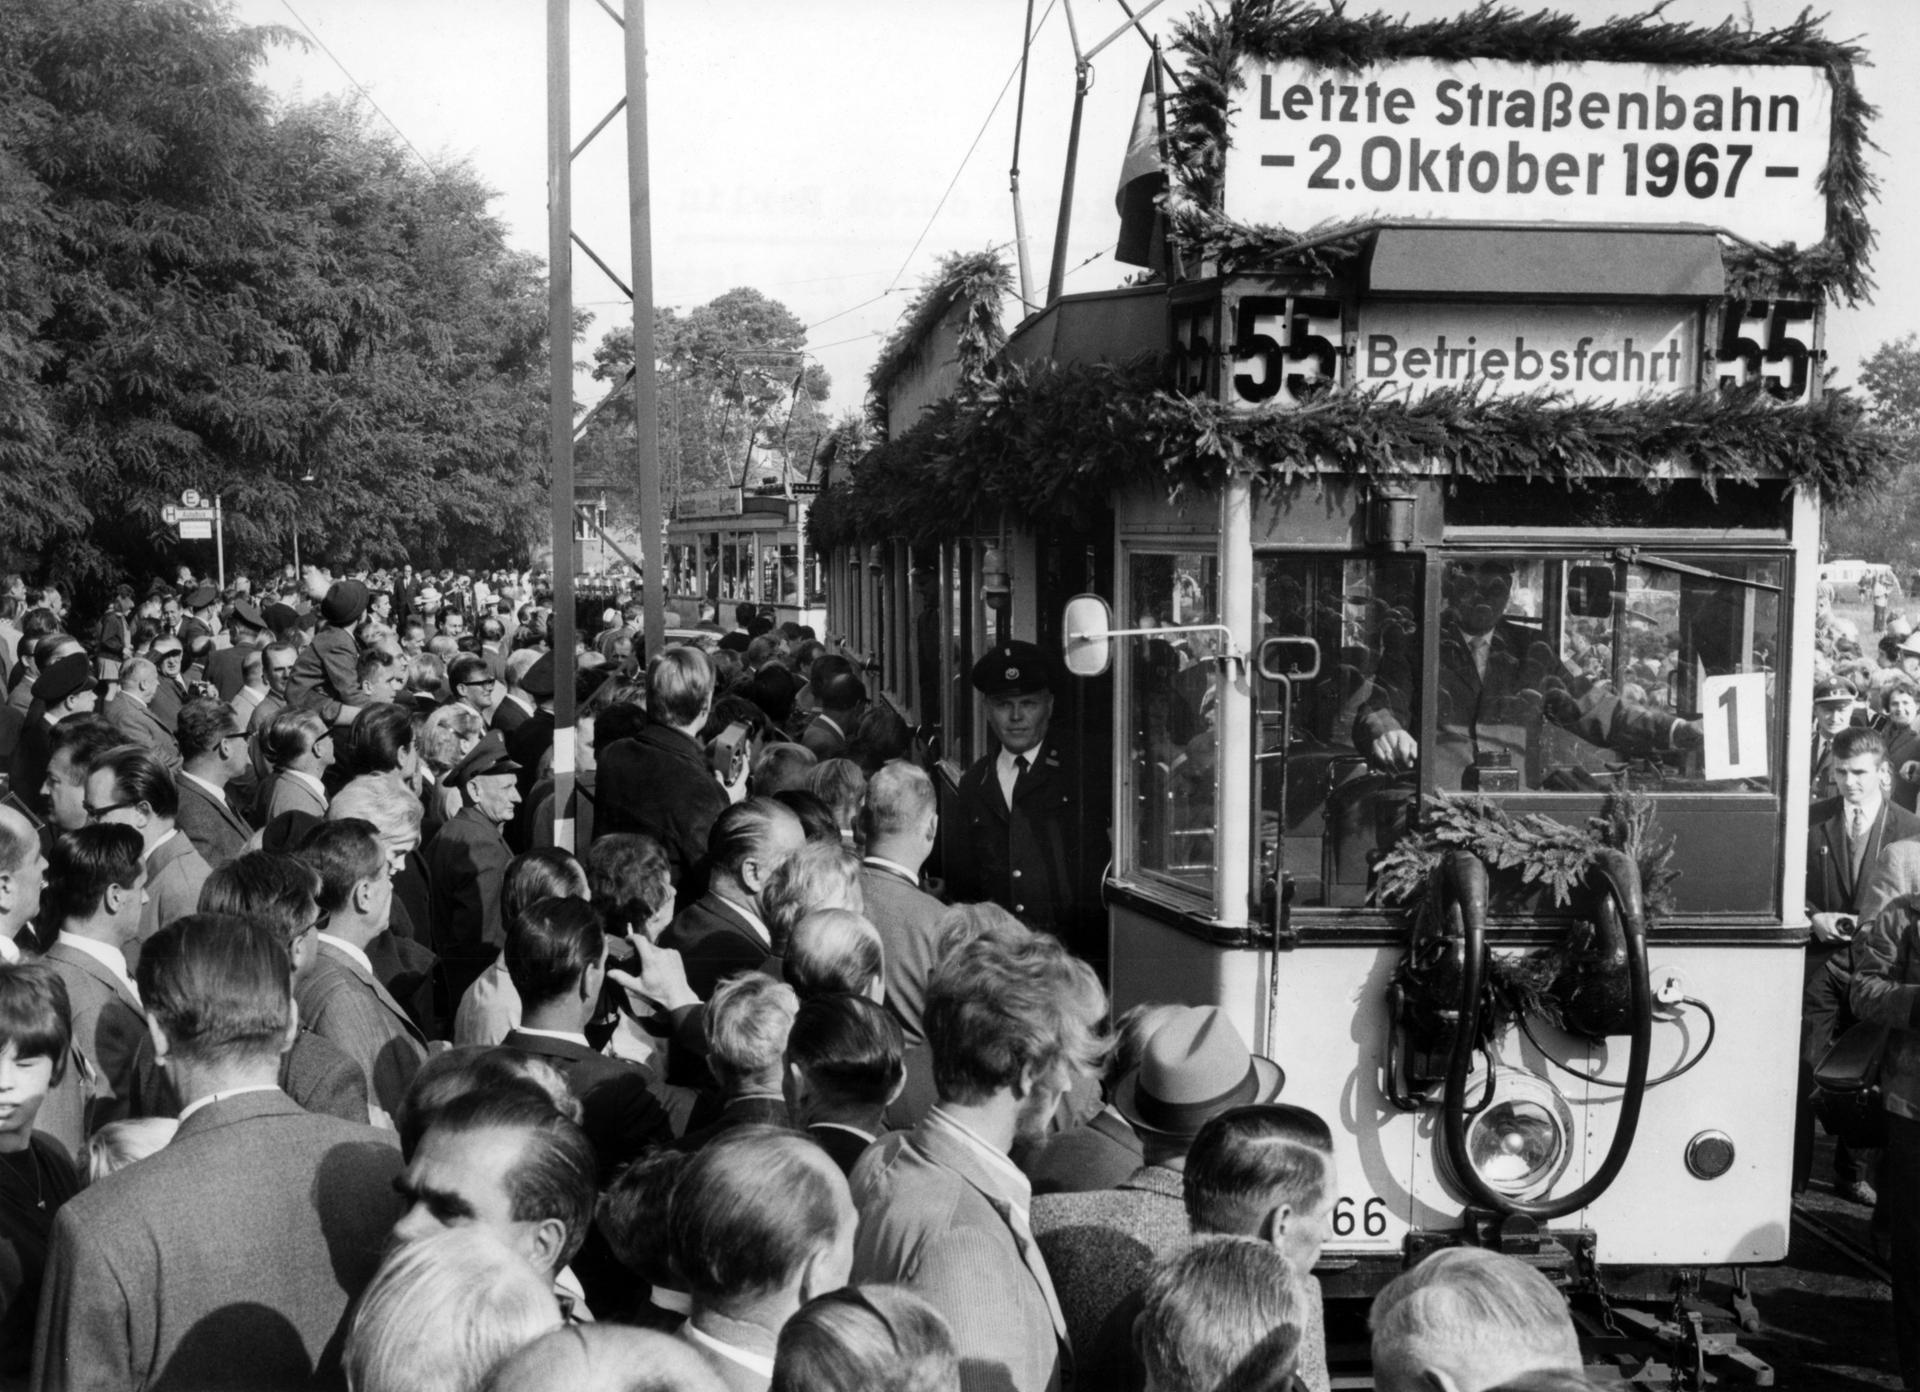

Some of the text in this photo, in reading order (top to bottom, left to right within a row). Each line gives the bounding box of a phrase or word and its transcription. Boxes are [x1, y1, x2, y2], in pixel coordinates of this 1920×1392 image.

[1259, 74, 1800, 133] Letzte Straßenbahn
[1622, 142, 1754, 200] 1967
[1233, 296, 1341, 403] 55
[1366, 334, 1681, 383] Betriebsfahrt
[1718, 300, 1814, 403] 55
[166, 506, 176, 521] H
[186, 491, 196, 505] E
[1718, 686, 1740, 765] 1
